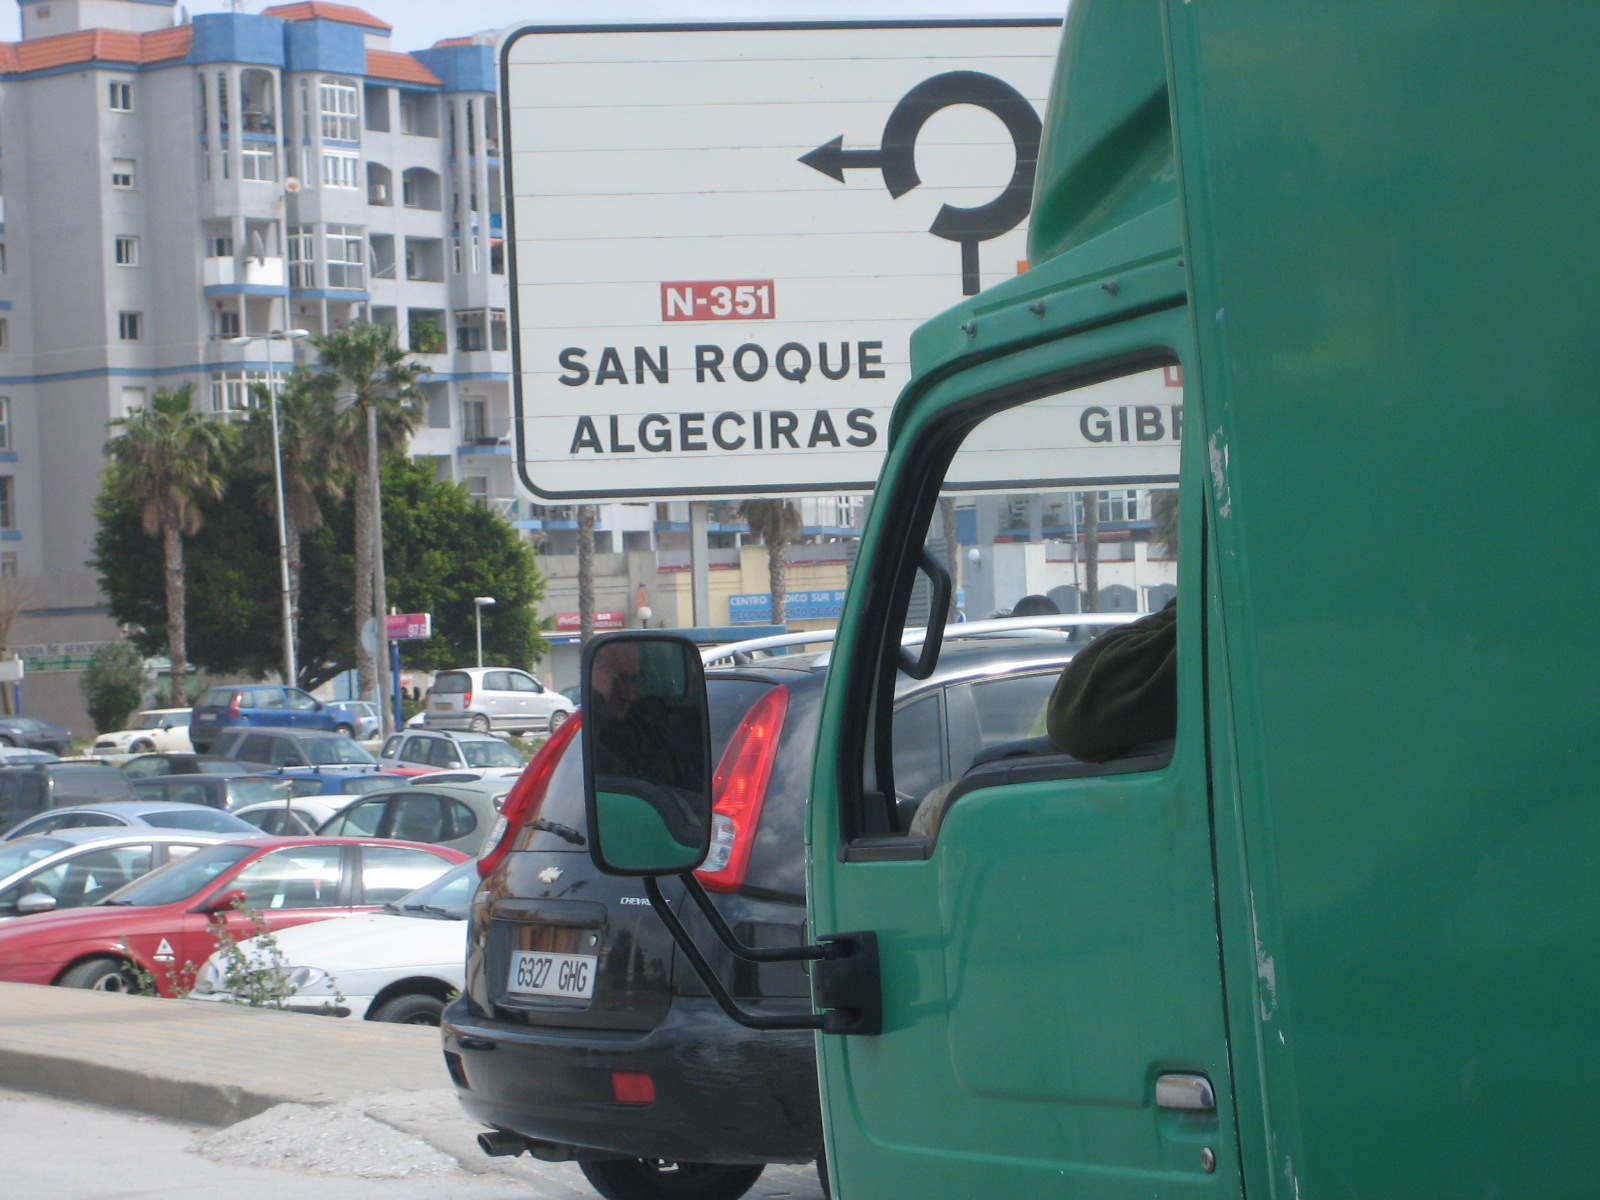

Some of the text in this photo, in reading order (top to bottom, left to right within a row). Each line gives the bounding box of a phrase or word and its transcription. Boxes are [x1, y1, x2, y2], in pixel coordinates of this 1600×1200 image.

[665, 284, 771, 317] N-351
[557, 341, 887, 387] SAN ROQUE
[569, 408, 878, 454] ALGECIRAS
[730, 596, 768, 606] CENTRO
[811, 592, 830, 602] SUR
[517, 957, 588, 992] 6327 GHG
